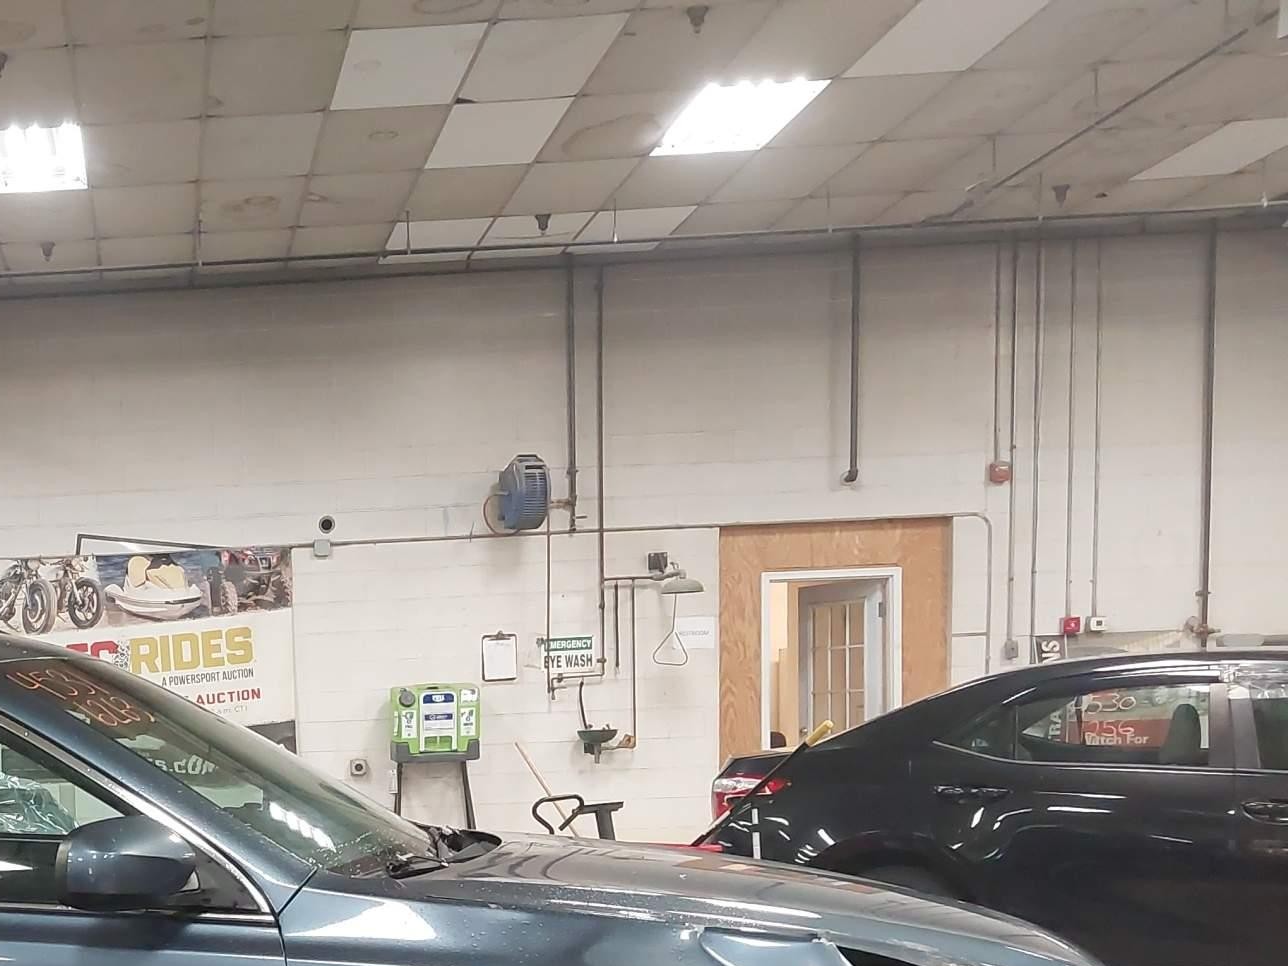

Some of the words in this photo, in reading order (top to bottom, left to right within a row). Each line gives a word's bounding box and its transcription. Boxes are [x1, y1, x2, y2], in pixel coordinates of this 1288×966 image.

[129, 626, 255, 675] RIDES
[565, 653, 592, 668] WASH
[162, 677, 167, 687] A
[169, 671, 221, 686] POWERSPORT
[222, 667, 254, 681] AUCTION
[196, 688, 261, 705] AUCTION
